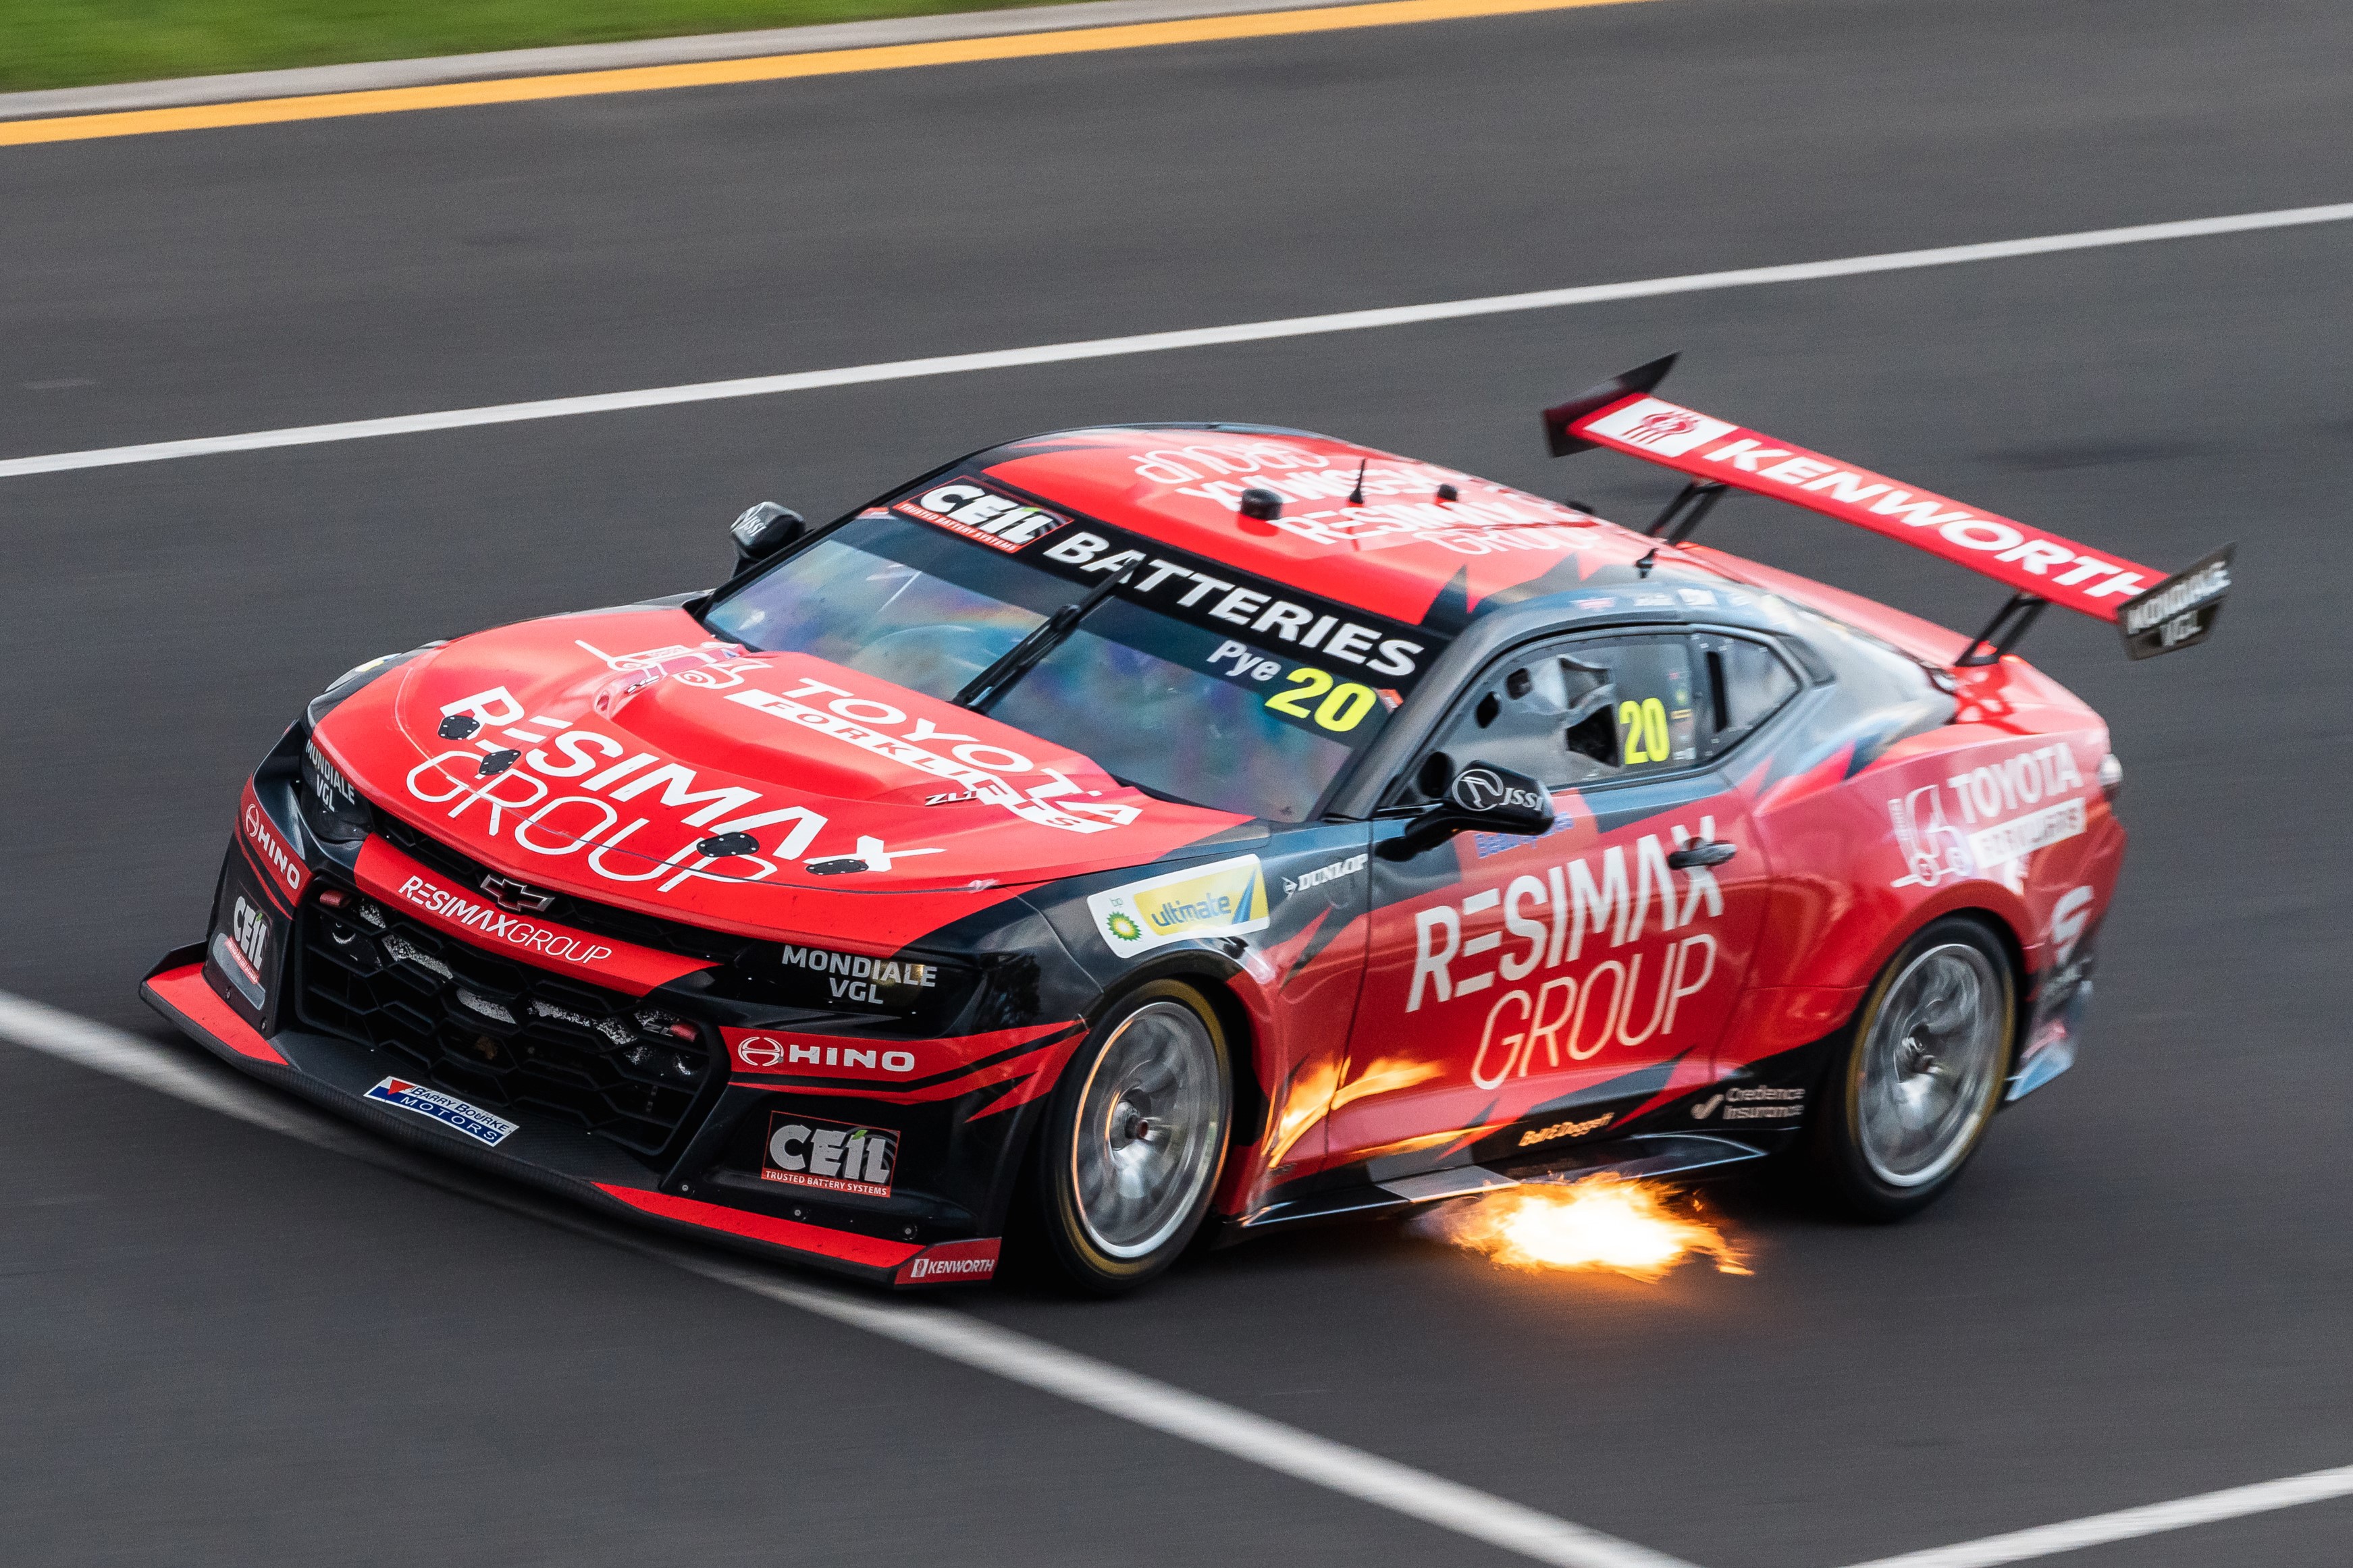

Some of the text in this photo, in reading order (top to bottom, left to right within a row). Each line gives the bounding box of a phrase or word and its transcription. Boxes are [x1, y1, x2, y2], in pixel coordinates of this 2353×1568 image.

[920, 485, 1053, 544] CEIL
[1042, 531, 1425, 677] BATTERIES
[1207, 639, 1282, 682] Pye
[1264, 668, 1378, 732] 20
[782, 677, 1144, 826] TOYOTA
[1619, 697, 1670, 764] 20
[305, 738, 355, 805] MONDIALE
[316, 774, 336, 813] VGL
[439, 685, 947, 873] RESIMAX
[924, 790, 979, 806] ZL1
[1947, 742, 2083, 823] TOYOTA
[406, 751, 778, 892] GROUP
[1498, 787, 1545, 811] JSSI
[258, 824, 300, 890] HINO
[1298, 853, 1369, 892] DUNLOP
[1109, 896, 1123, 908] bp
[1151, 892, 1231, 928] ultimate
[1406, 815, 1724, 1012] RESIMAX
[234, 896, 267, 971] CEIL
[782, 944, 938, 988] MONDIALE
[829, 977, 884, 1005] VGL
[1471, 934, 1717, 1091] GROUP
[789, 1045, 915, 1072] HINO
[400, 1096, 498, 1141] MOTORS
[411, 1085, 510, 1133] BARRY BOURKE
[770, 1124, 890, 1184] CEIL
[766, 1170, 887, 1196] TRUSTED BATTERY SYSTEMS
[928, 1259, 995, 1274] KENWORTH
